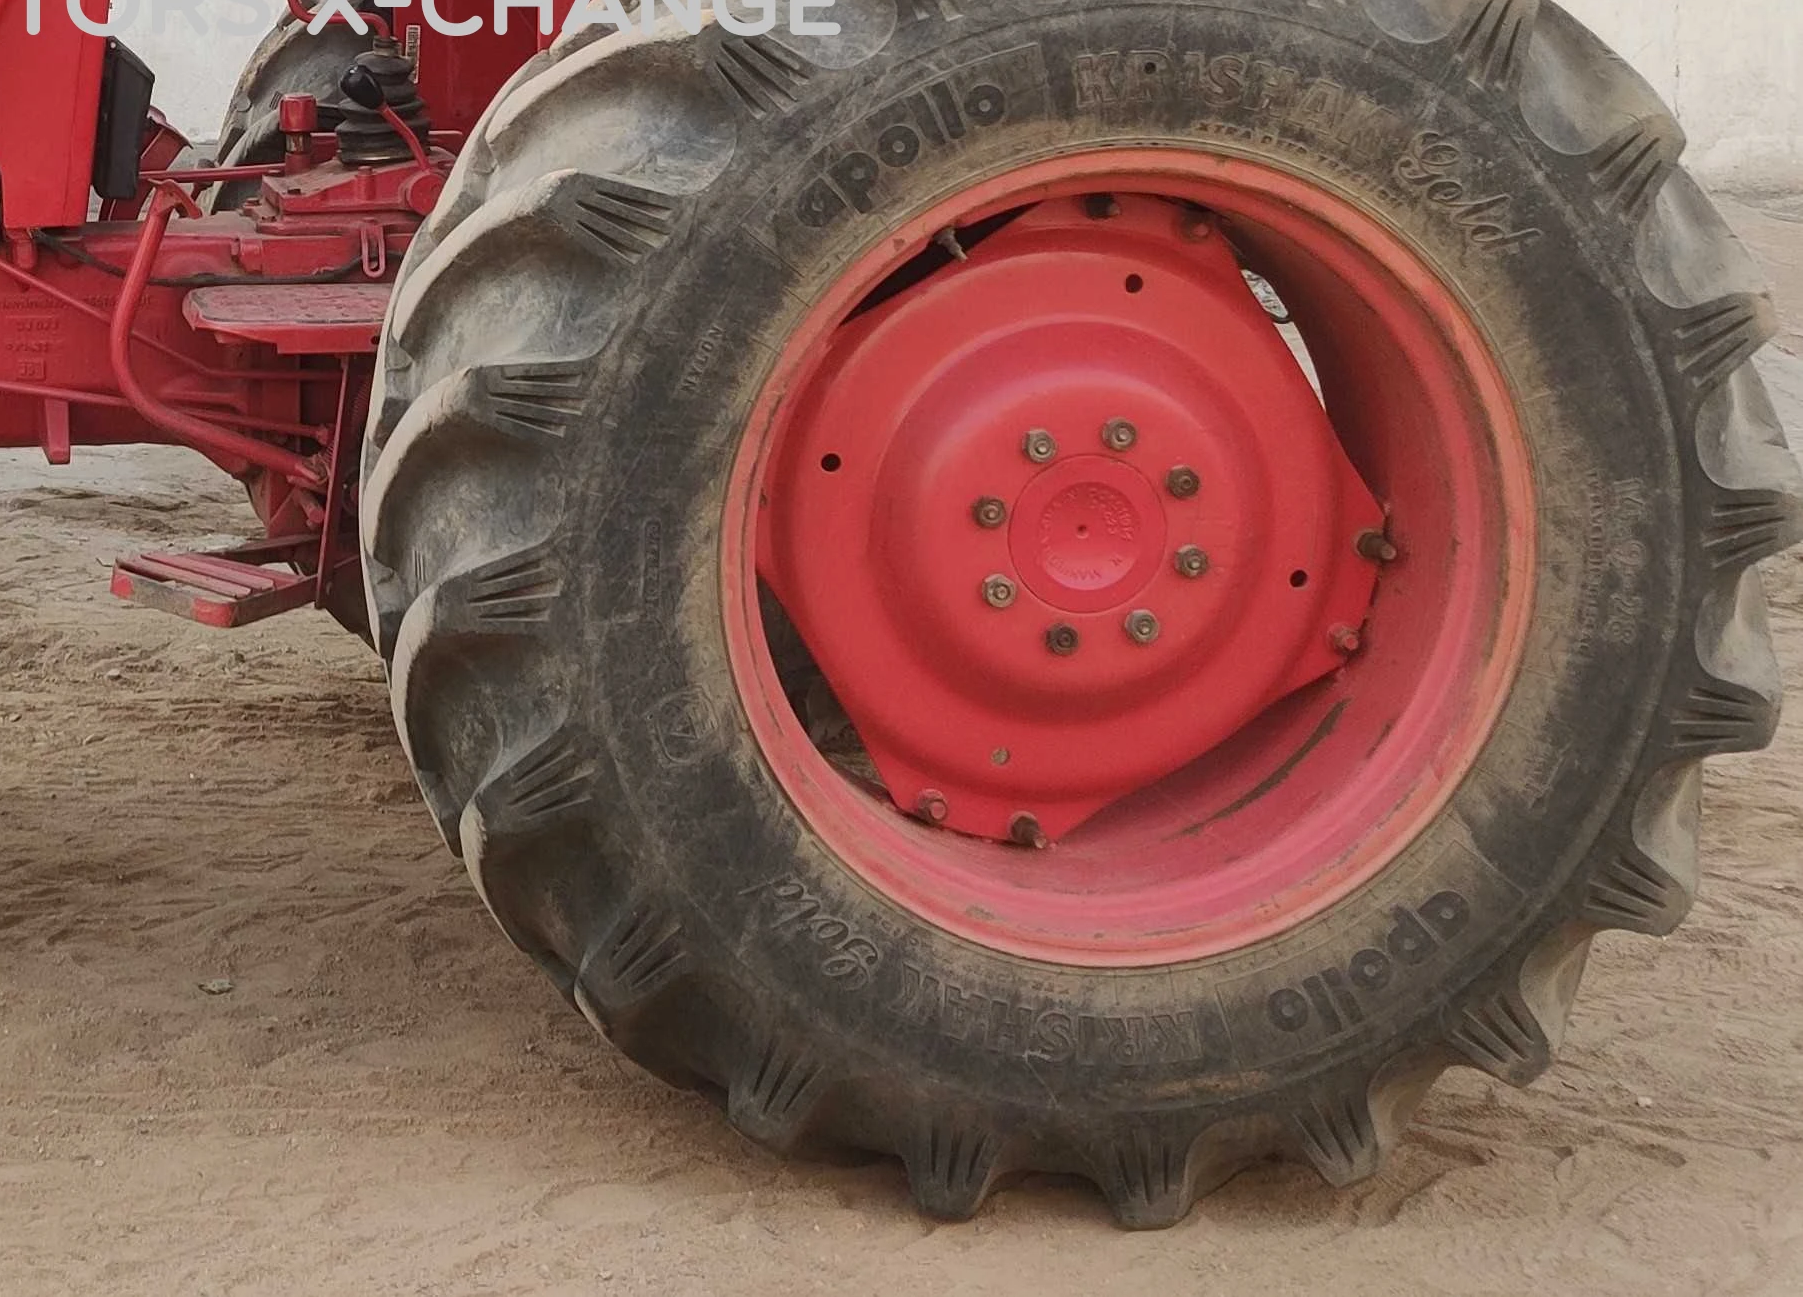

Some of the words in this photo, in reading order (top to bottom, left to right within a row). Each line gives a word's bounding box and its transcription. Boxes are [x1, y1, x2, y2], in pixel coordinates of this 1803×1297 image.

[792, 75, 1007, 229] apollo
[680, 322, 727, 395] NYLON
[1265, 887, 1473, 1034] apollo
